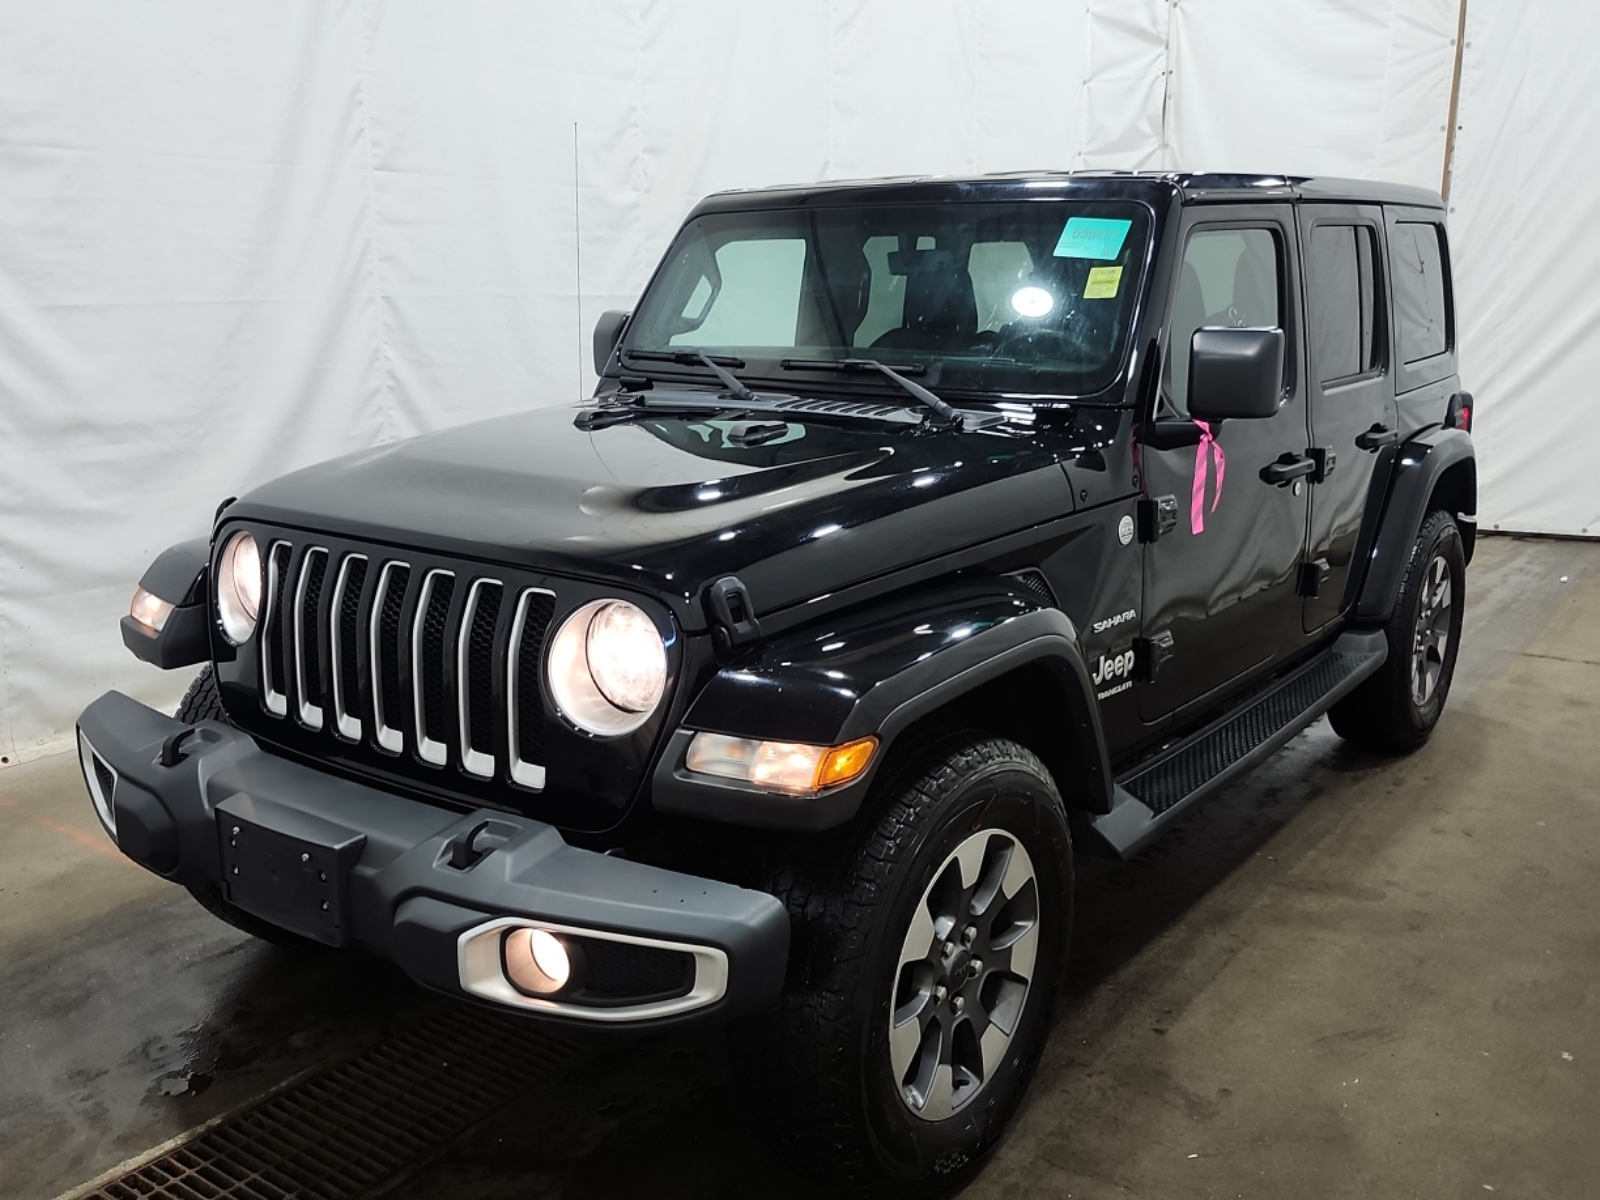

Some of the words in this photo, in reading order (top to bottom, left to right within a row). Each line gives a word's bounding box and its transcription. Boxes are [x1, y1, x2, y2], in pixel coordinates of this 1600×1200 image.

[1092, 608, 1137, 634] SAHARA
[1092, 650, 1135, 685] Jeep
[1097, 680, 1133, 701] RANGLER
